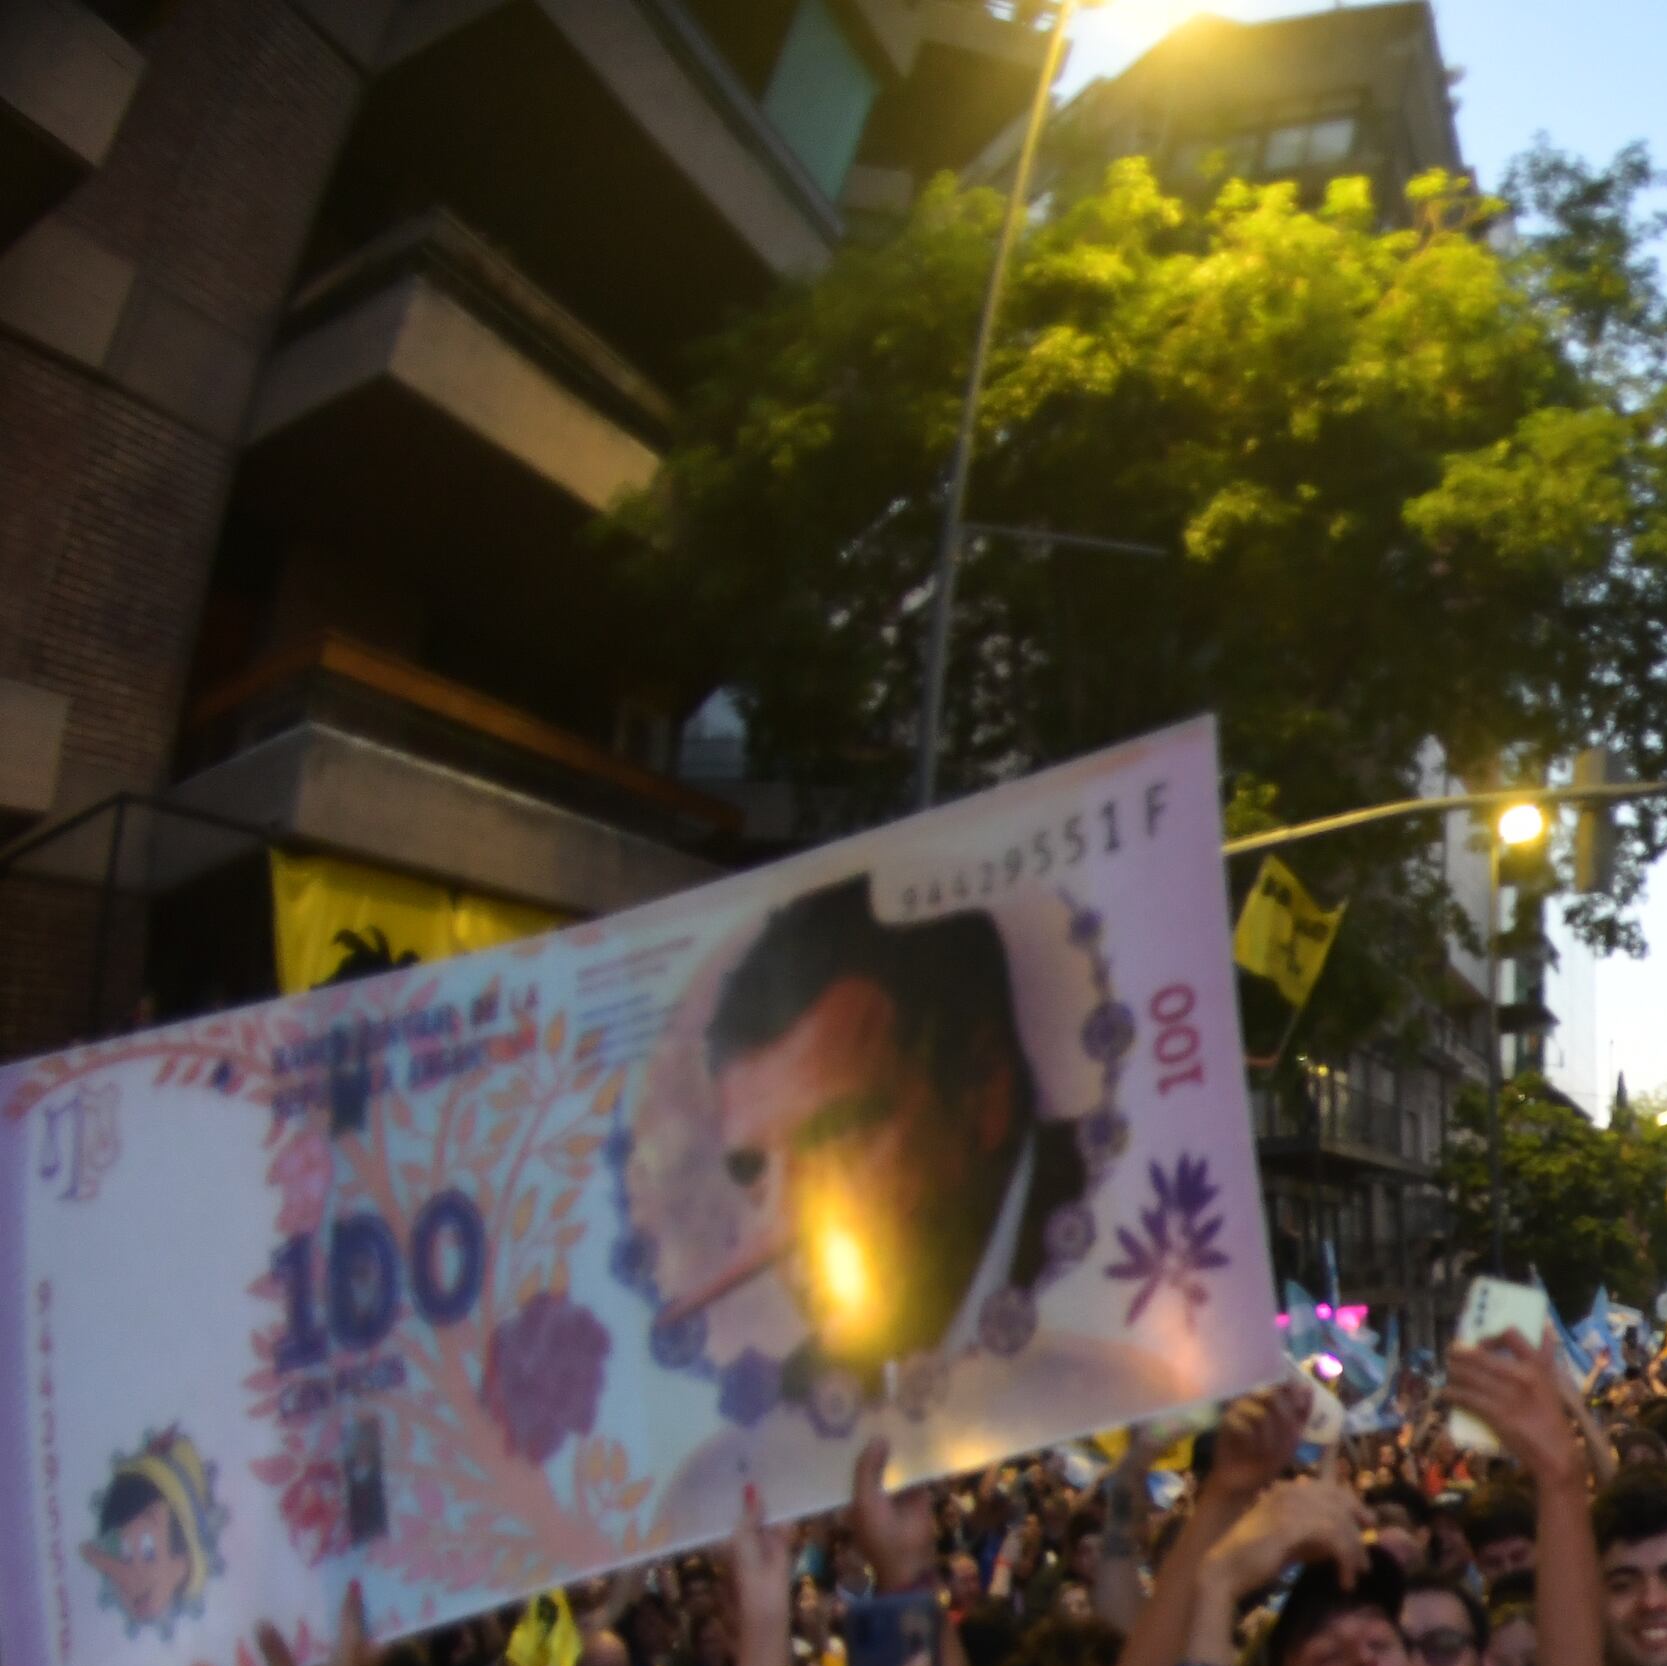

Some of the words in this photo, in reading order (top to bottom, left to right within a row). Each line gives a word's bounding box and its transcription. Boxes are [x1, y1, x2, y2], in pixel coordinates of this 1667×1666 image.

[1145, 780, 1168, 837] F
[1149, 982, 1205, 1097] 100
[270, 1186, 488, 1372] 100
